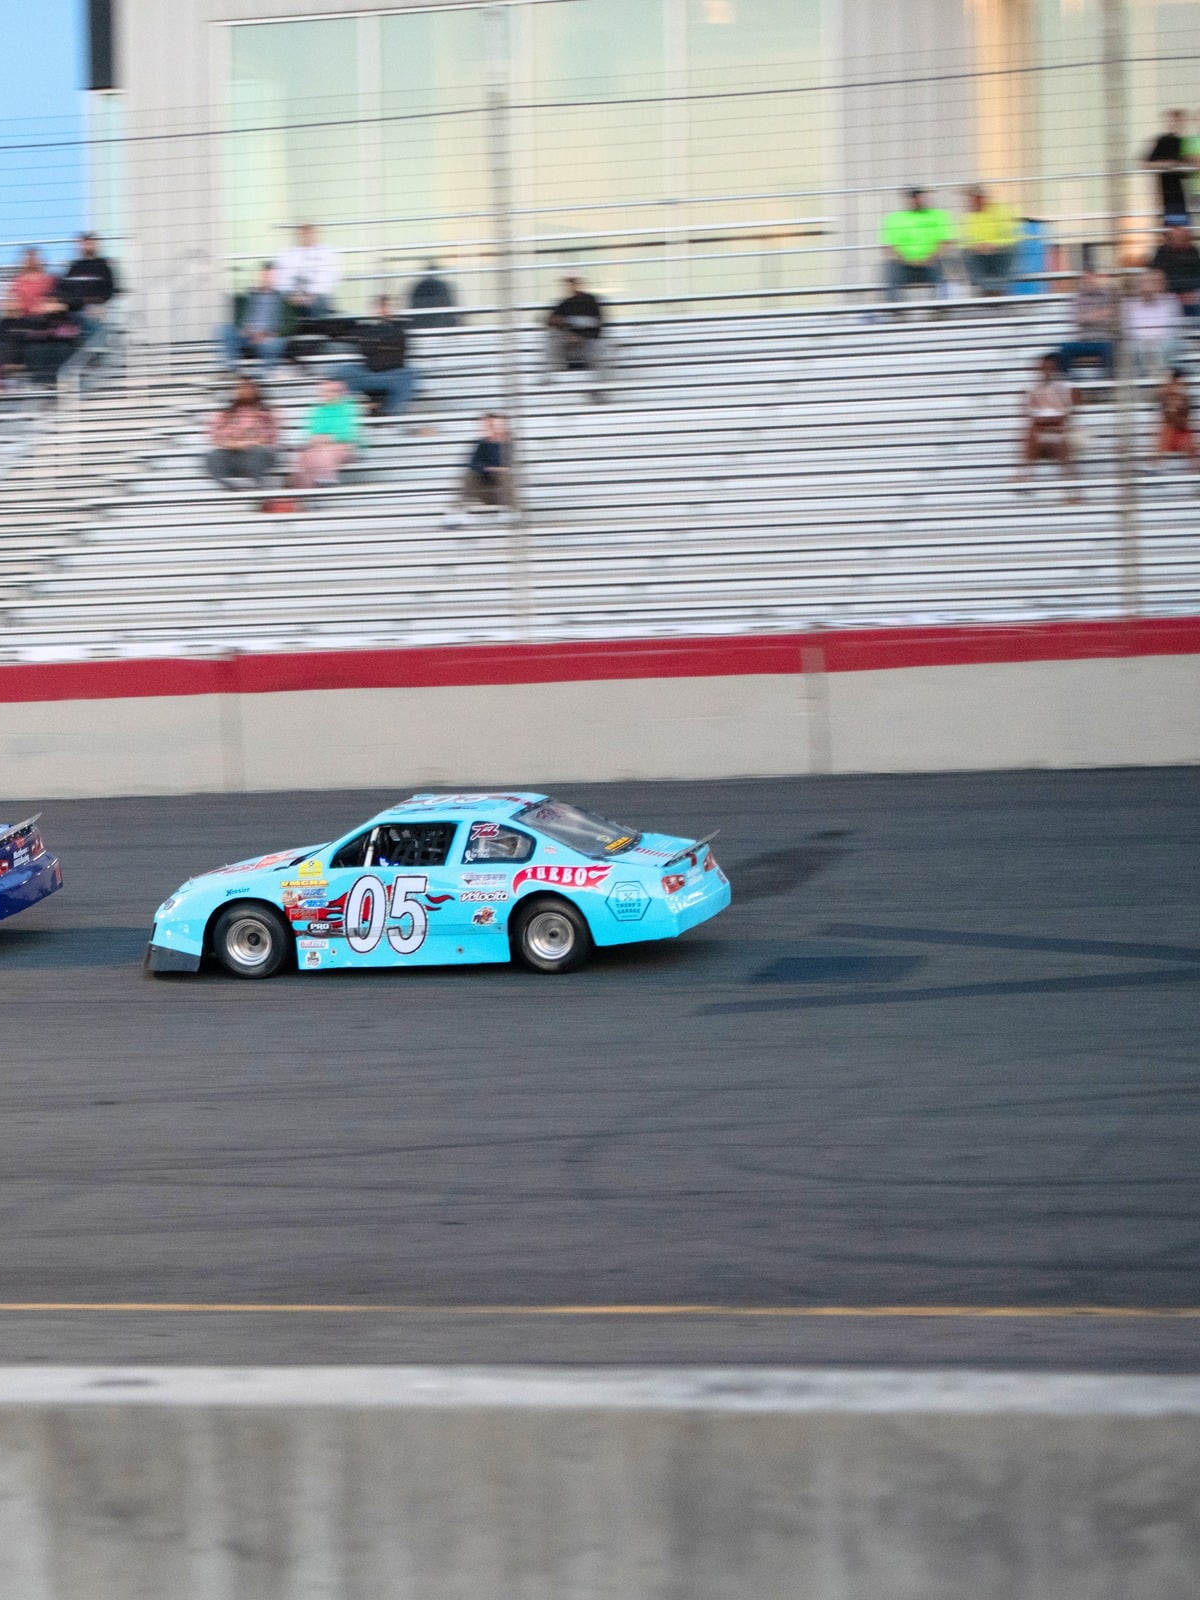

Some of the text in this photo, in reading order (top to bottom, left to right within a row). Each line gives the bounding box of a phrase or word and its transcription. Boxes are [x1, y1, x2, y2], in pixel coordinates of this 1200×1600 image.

[524, 868, 588, 885] TURBO
[226, 887, 250, 896] Hoosier
[345, 875, 428, 954] 05
